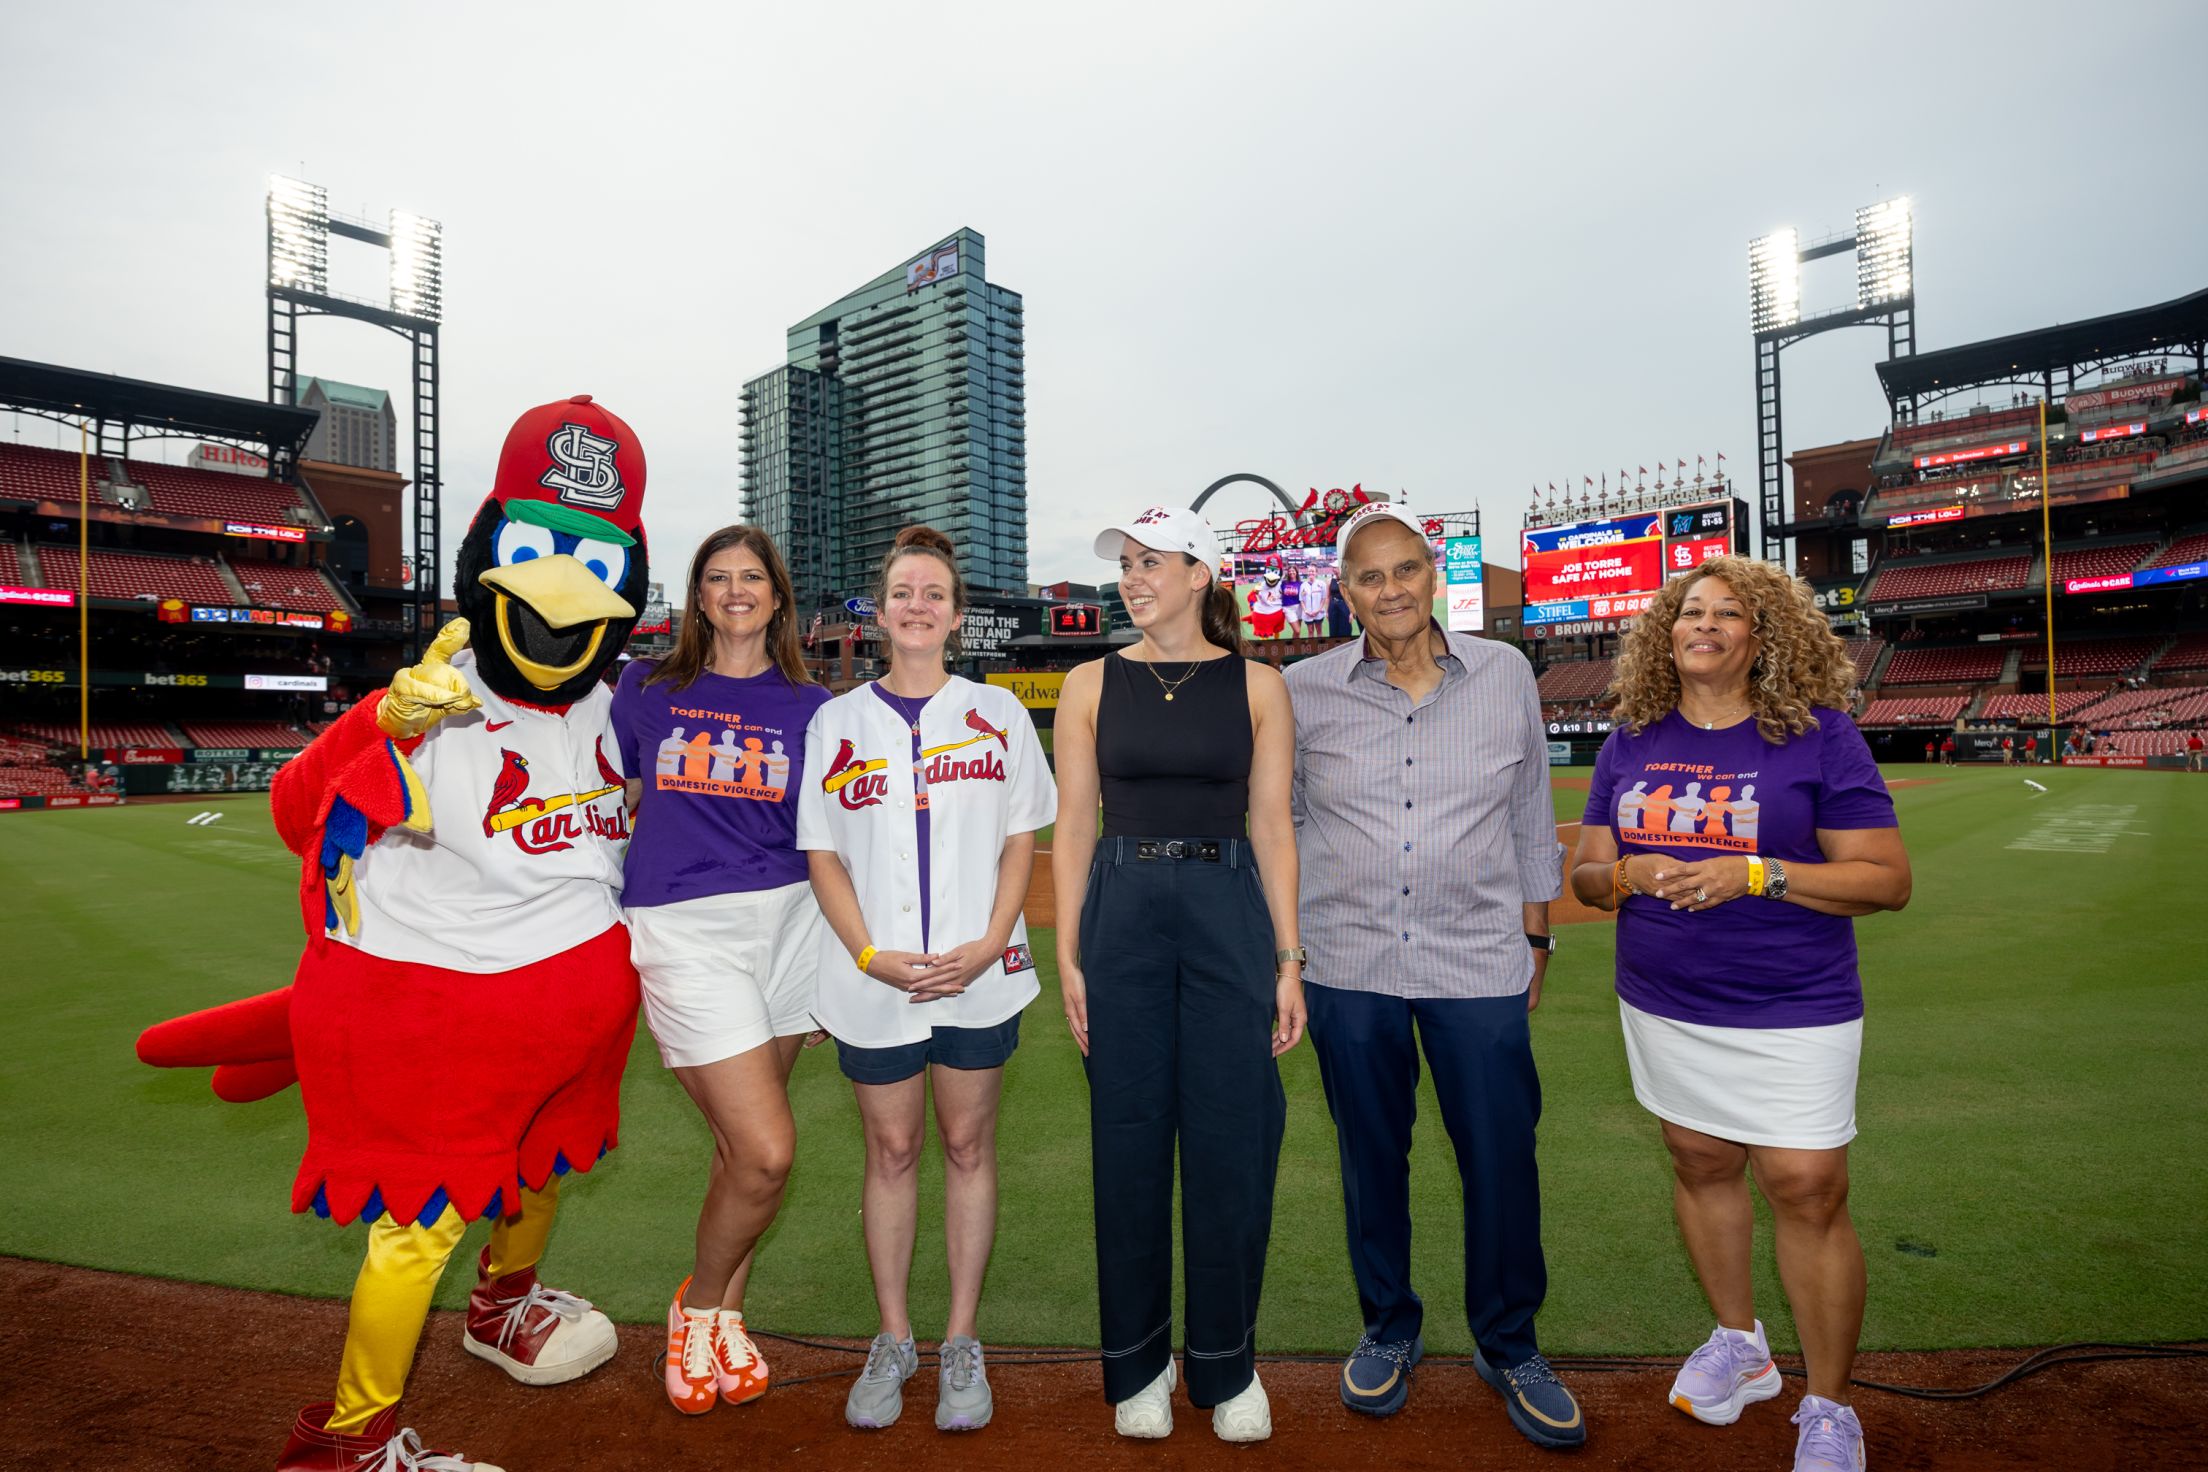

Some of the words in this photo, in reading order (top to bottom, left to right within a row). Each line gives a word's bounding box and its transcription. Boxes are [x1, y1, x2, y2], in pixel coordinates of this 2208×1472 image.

[2111, 382, 2178, 399] BUDWEISER
[1542, 502, 1601, 522] WORLD
[1605, 487, 1711, 511] CHAMPIONS
[1702, 511, 1722, 519] RECORD
[1702, 517, 1723, 527] 51-55
[1557, 533, 1625, 550] WELCOME
[1568, 529, 1613, 541] CARDINALS
[1561, 563, 1583, 574] JOE
[1584, 557, 1622, 571] TORRE
[1552, 573, 1580, 584] SAFE
[1582, 570, 1597, 581] AT
[1599, 566, 1632, 579] HOME
[2069, 580, 2101, 591] Cardinals
[2110, 577, 2131, 587] CARE
[1813, 587, 1860, 608] et3
[1538, 605, 1575, 619] STIFEL
[1874, 606, 1894, 614] Mercy
[192, 608, 229, 623] BIG
[231, 609, 275, 625] MAC
[276, 612, 323, 629] LAND
[961, 615, 995, 628] FROM
[996, 617, 1020, 629] THE
[961, 627, 984, 638] LOU
[986, 628, 1012, 640] AND
[1555, 622, 1604, 636] BROWN
[1608, 622, 1616, 631] &
[961, 638, 998, 650] WE'RE
[0, 669, 65, 683] bet365
[144, 672, 207, 687] bet365
[670, 706, 742, 723] TOGETHER
[727, 722, 742, 730] we
[744, 724, 763, 732] can
[764, 727, 783, 735] end
[1563, 724, 1580, 732] 6:10
[1974, 738, 1993, 748] Mercy
[1644, 763, 1714, 774] TOGETHER
[1737, 771, 1758, 779] end
[662, 778, 719, 792] DOMESTIC
[723, 784, 778, 799] VIOLENCE
[1624, 831, 1682, 842] DOMESTIC
[1686, 836, 1749, 849] VIOLENCE
